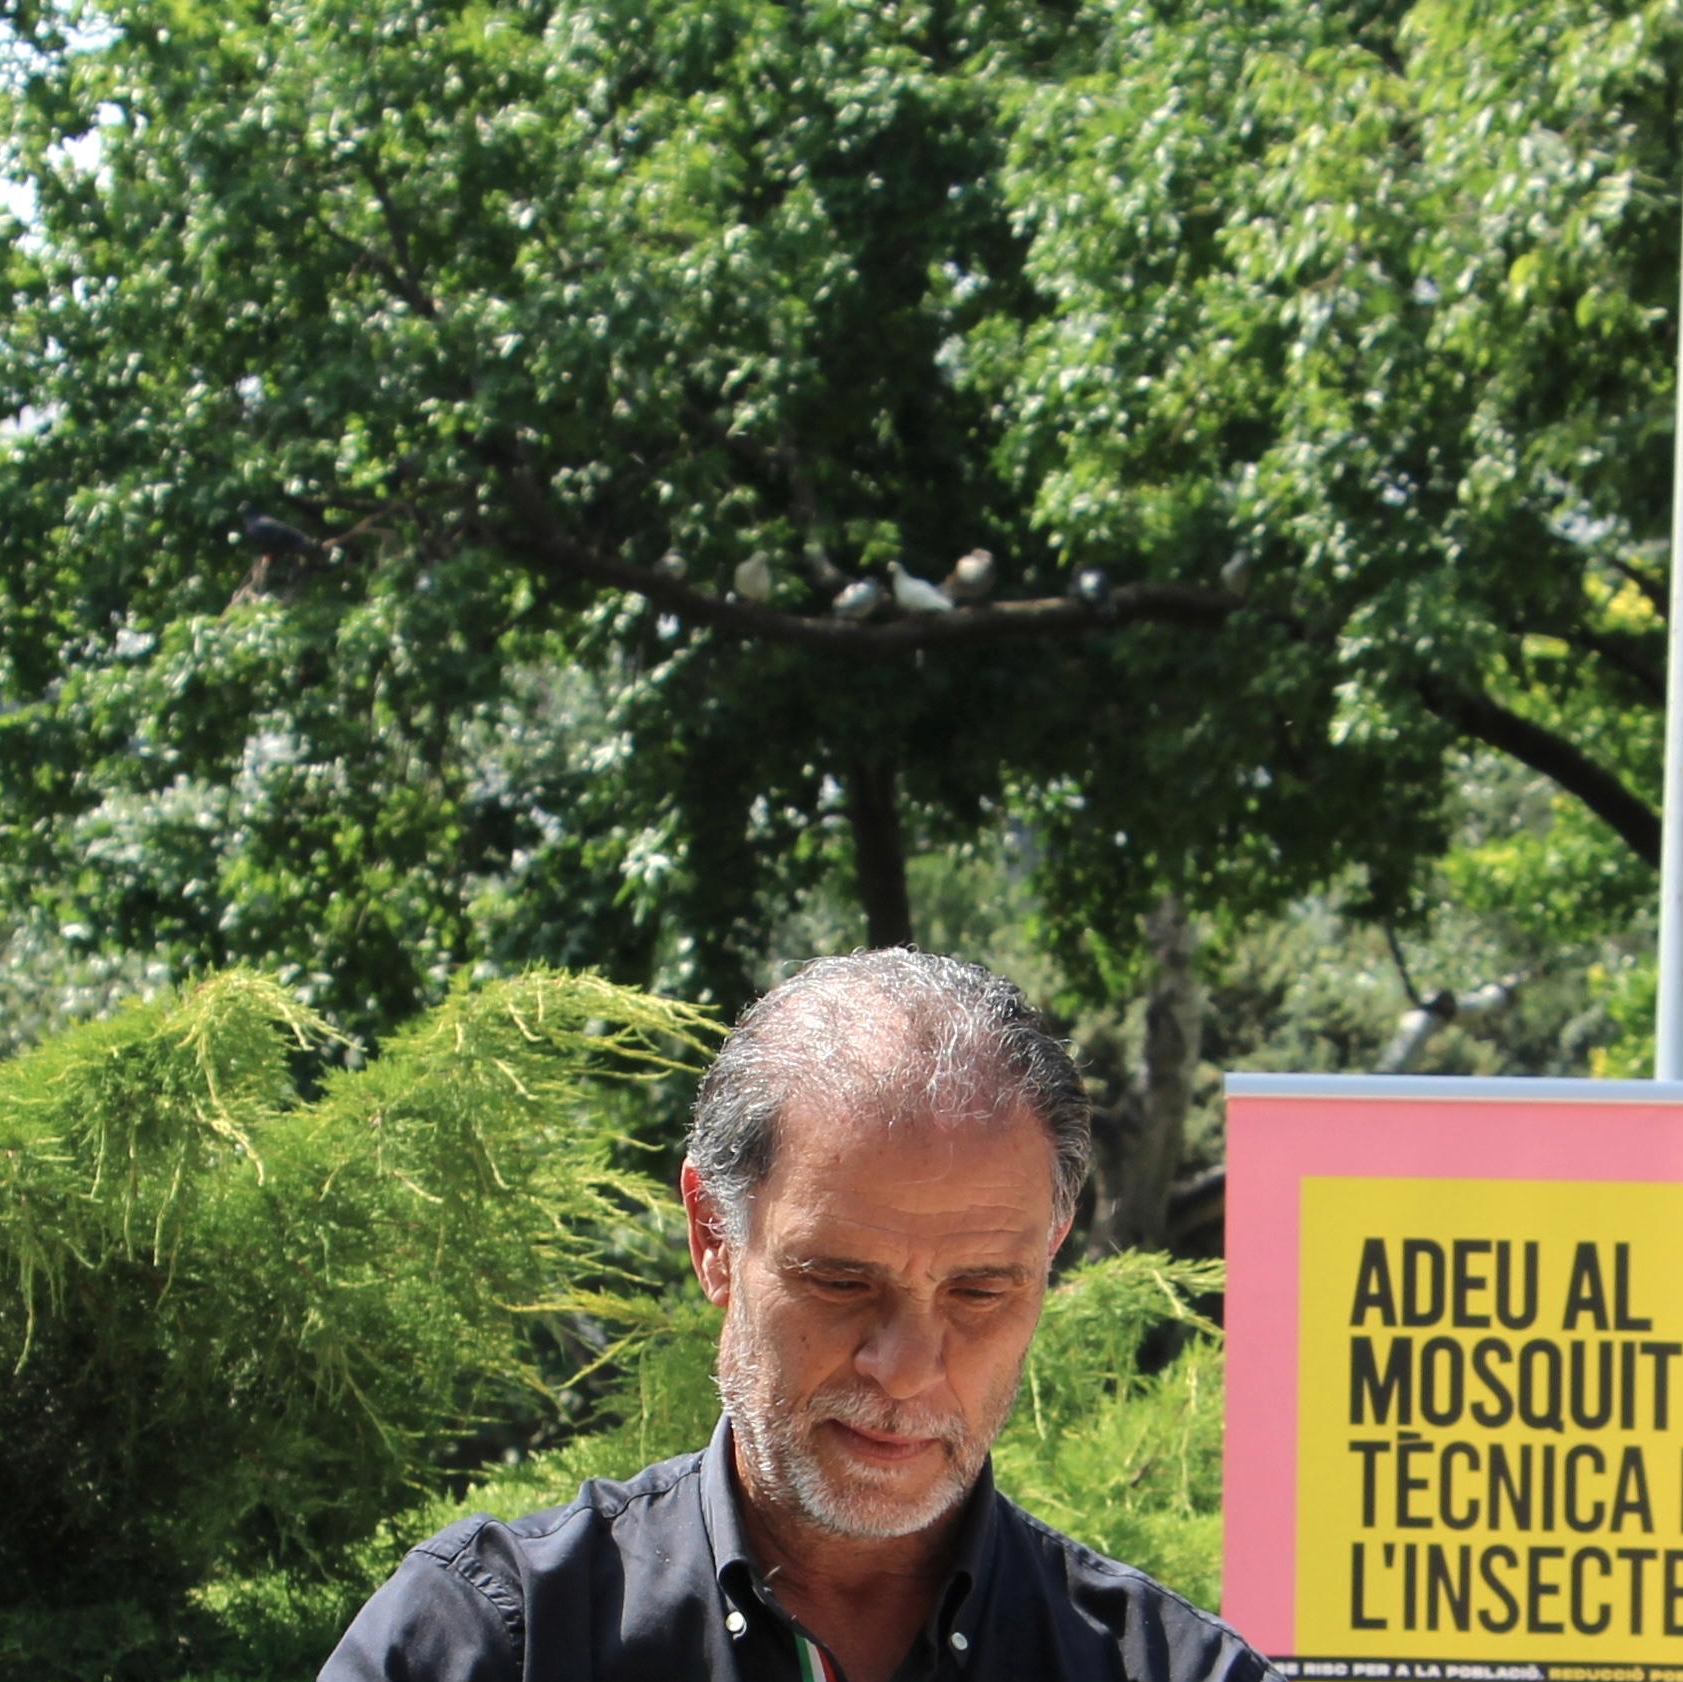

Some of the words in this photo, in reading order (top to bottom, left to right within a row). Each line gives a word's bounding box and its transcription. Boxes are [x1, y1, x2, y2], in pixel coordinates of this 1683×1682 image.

[1349, 1237, 1539, 1331] ADEU
[1561, 1241, 1653, 1332] AL
[1349, 1336, 1683, 1434] MOSQUIT
[1348, 1430, 1655, 1534] TÈCNICA
[1303, 1662, 1348, 1677] RISC
[1352, 1663, 1389, 1678] PER
[1394, 1664, 1409, 1678] A
[1414, 1664, 1441, 1679] LA
[1445, 1662, 1544, 1680] POBLACIÓ.
